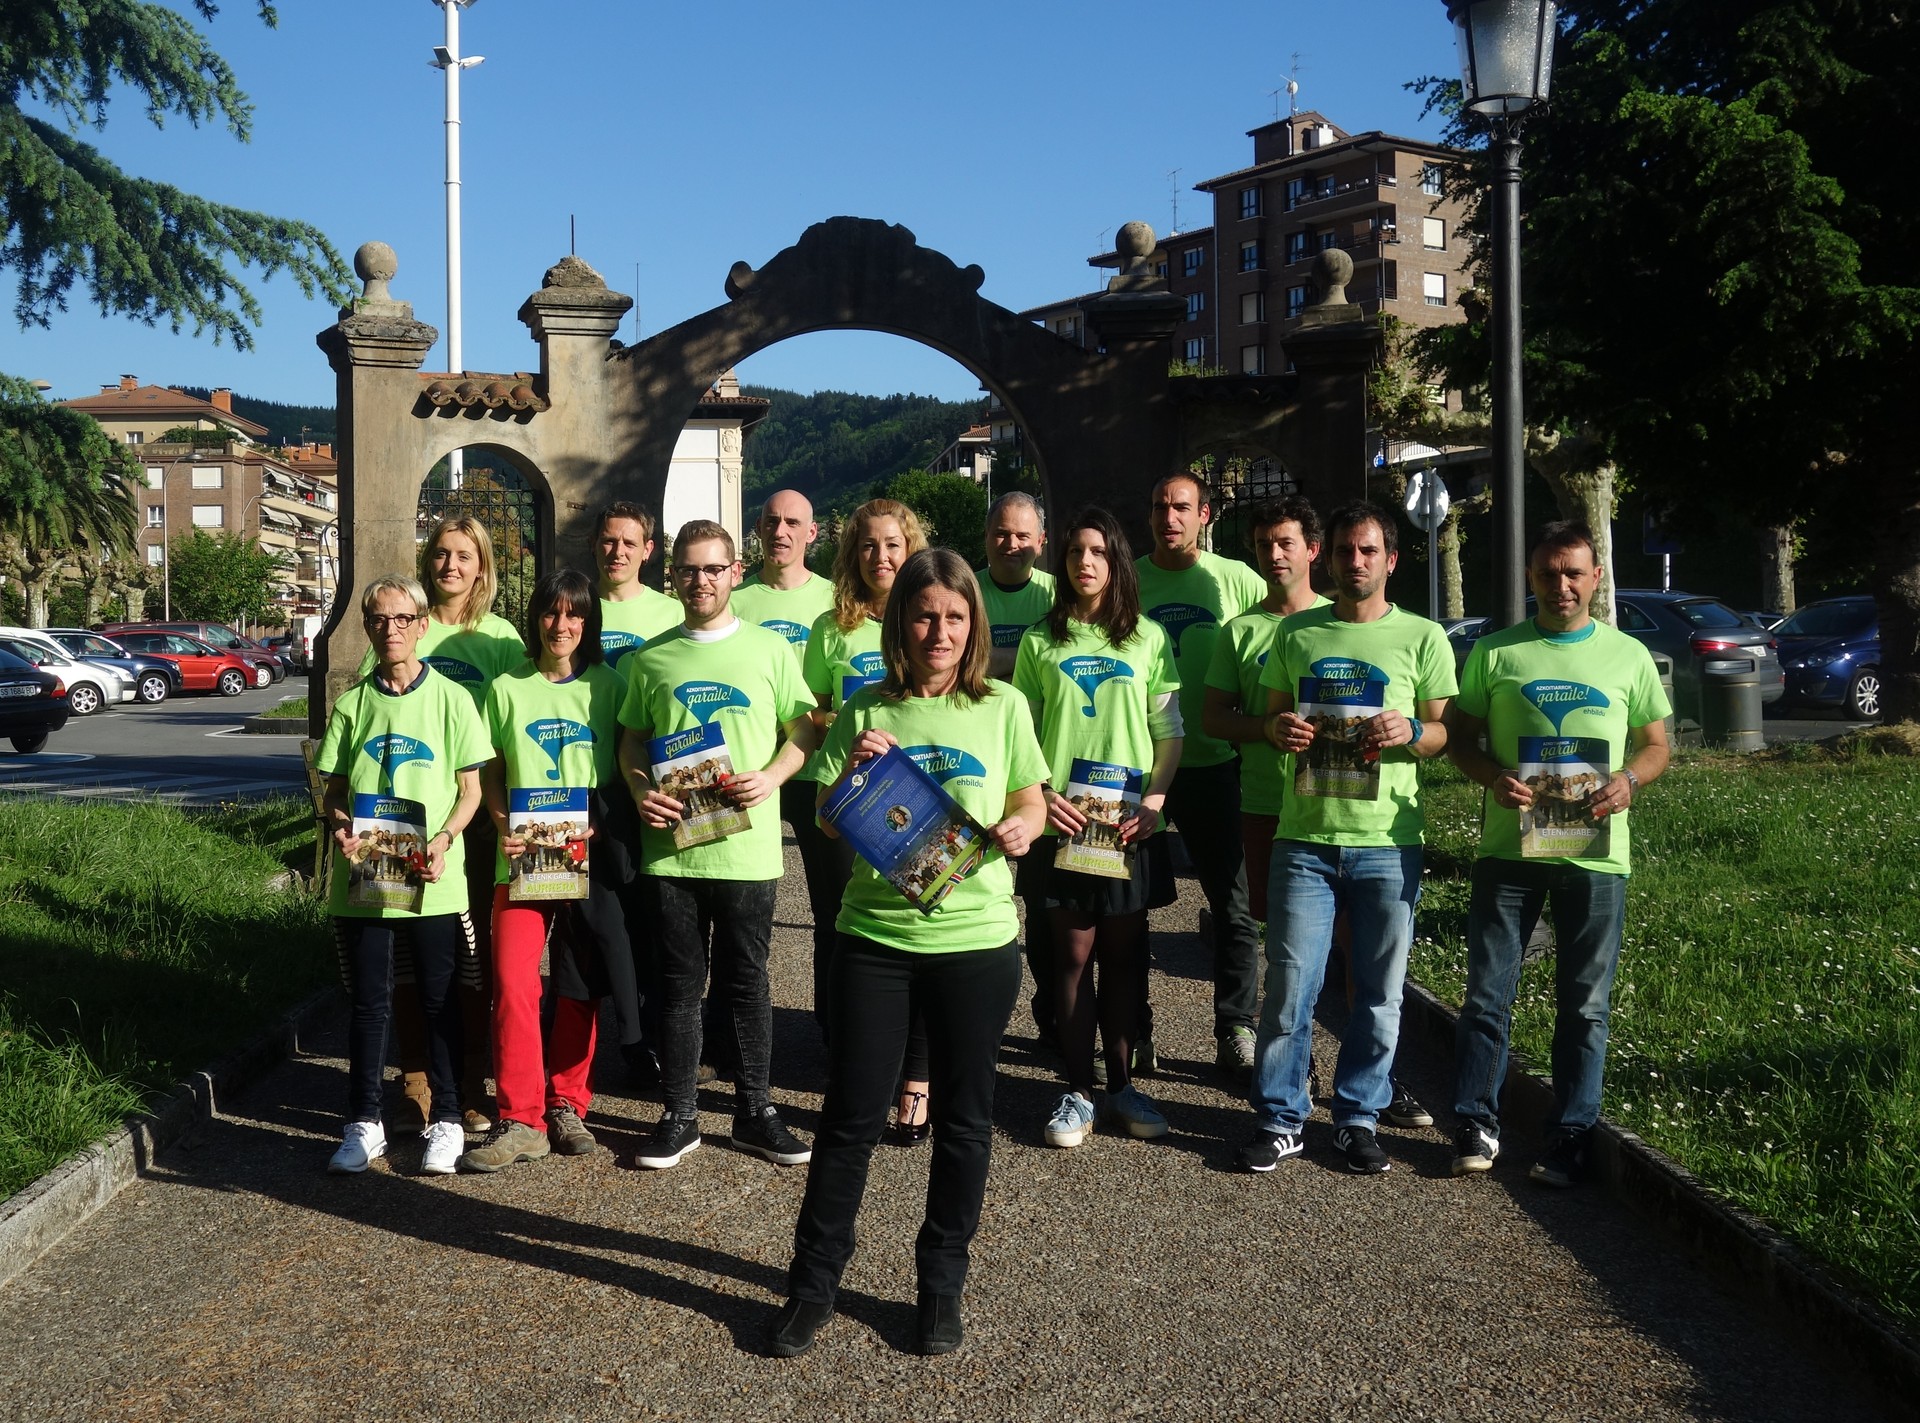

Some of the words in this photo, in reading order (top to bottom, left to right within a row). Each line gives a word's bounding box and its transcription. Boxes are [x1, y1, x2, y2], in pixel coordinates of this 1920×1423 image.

[601, 635, 636, 649] araile!
[1073, 660, 1116, 681] garaile!
[687, 687, 733, 709] garaile!
[1319, 681, 1366, 700] garaile!
[1537, 686, 1589, 708] garaile!
[1583, 708, 1605, 716] ehbildu
[538, 725, 581, 746] garaile!
[665, 726, 704, 759] garaile!
[956, 778, 984, 787] ehbildu
[528, 788, 571, 811] garaile!
[528, 873, 552, 881] ETENIK
[526, 882, 576, 893] AURRERA
